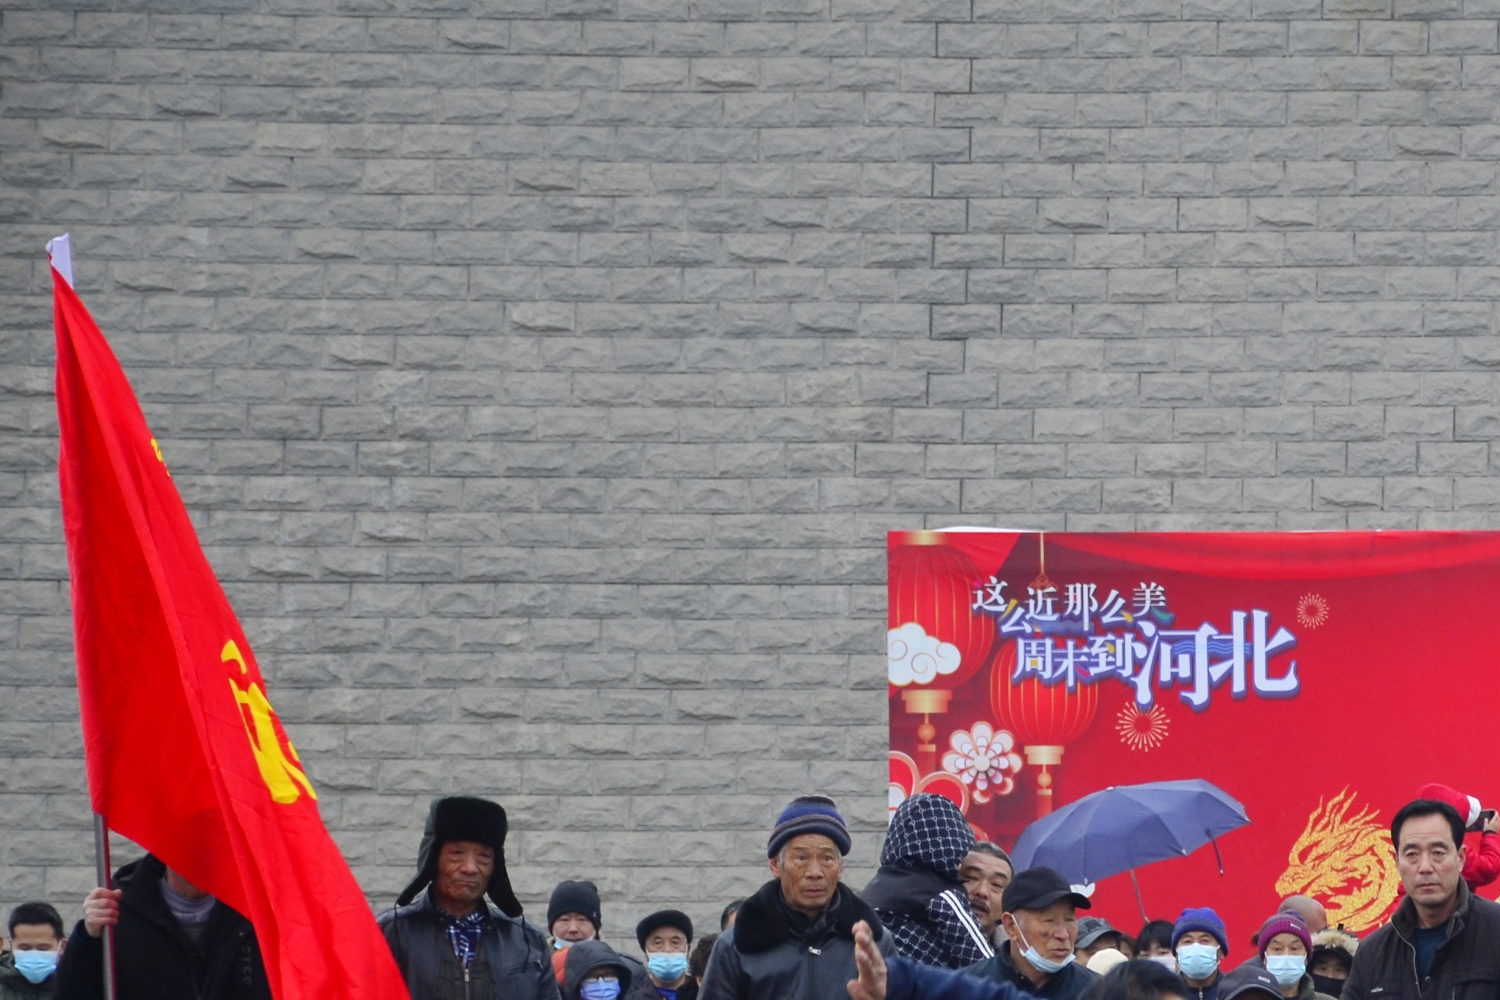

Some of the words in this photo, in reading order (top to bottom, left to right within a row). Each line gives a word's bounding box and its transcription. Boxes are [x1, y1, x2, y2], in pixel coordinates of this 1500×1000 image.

[971, 575, 1174, 634] 这么近那么美
[1011, 609, 1299, 706] 周末到河北
